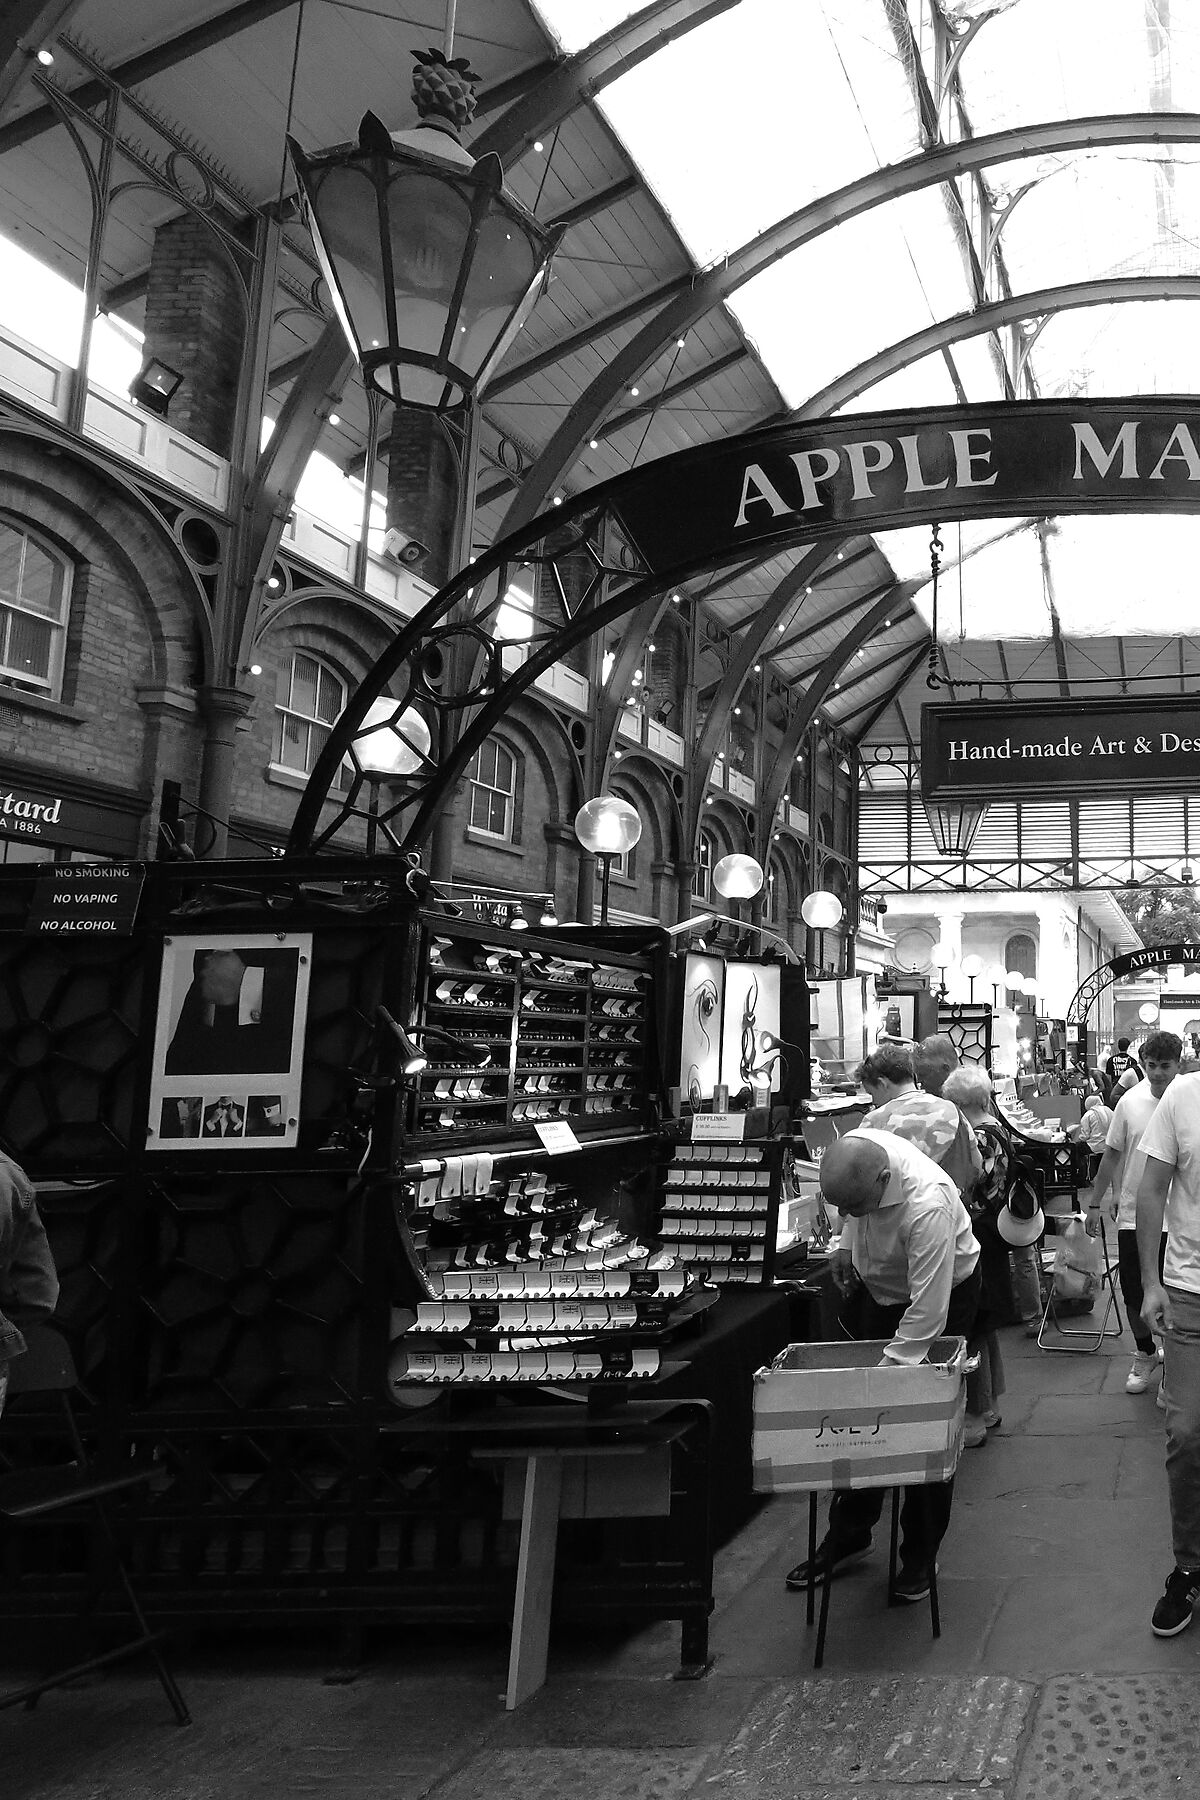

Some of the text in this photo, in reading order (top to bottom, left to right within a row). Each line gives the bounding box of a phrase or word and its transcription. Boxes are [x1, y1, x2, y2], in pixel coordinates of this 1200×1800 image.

[733, 427, 999, 528] APPLE
[948, 736, 1082, 761] Hand-made
[1088, 735, 1126, 756] Art
[1133, 735, 1152, 755] &
[14, 820, 41, 834] 1886
[55, 868, 130, 878] NO SMOKING
[53, 894, 118, 904] NO VAPING
[40, 921, 117, 930] NO ALCOHOL
[1130, 949, 1172, 969] APPLE
